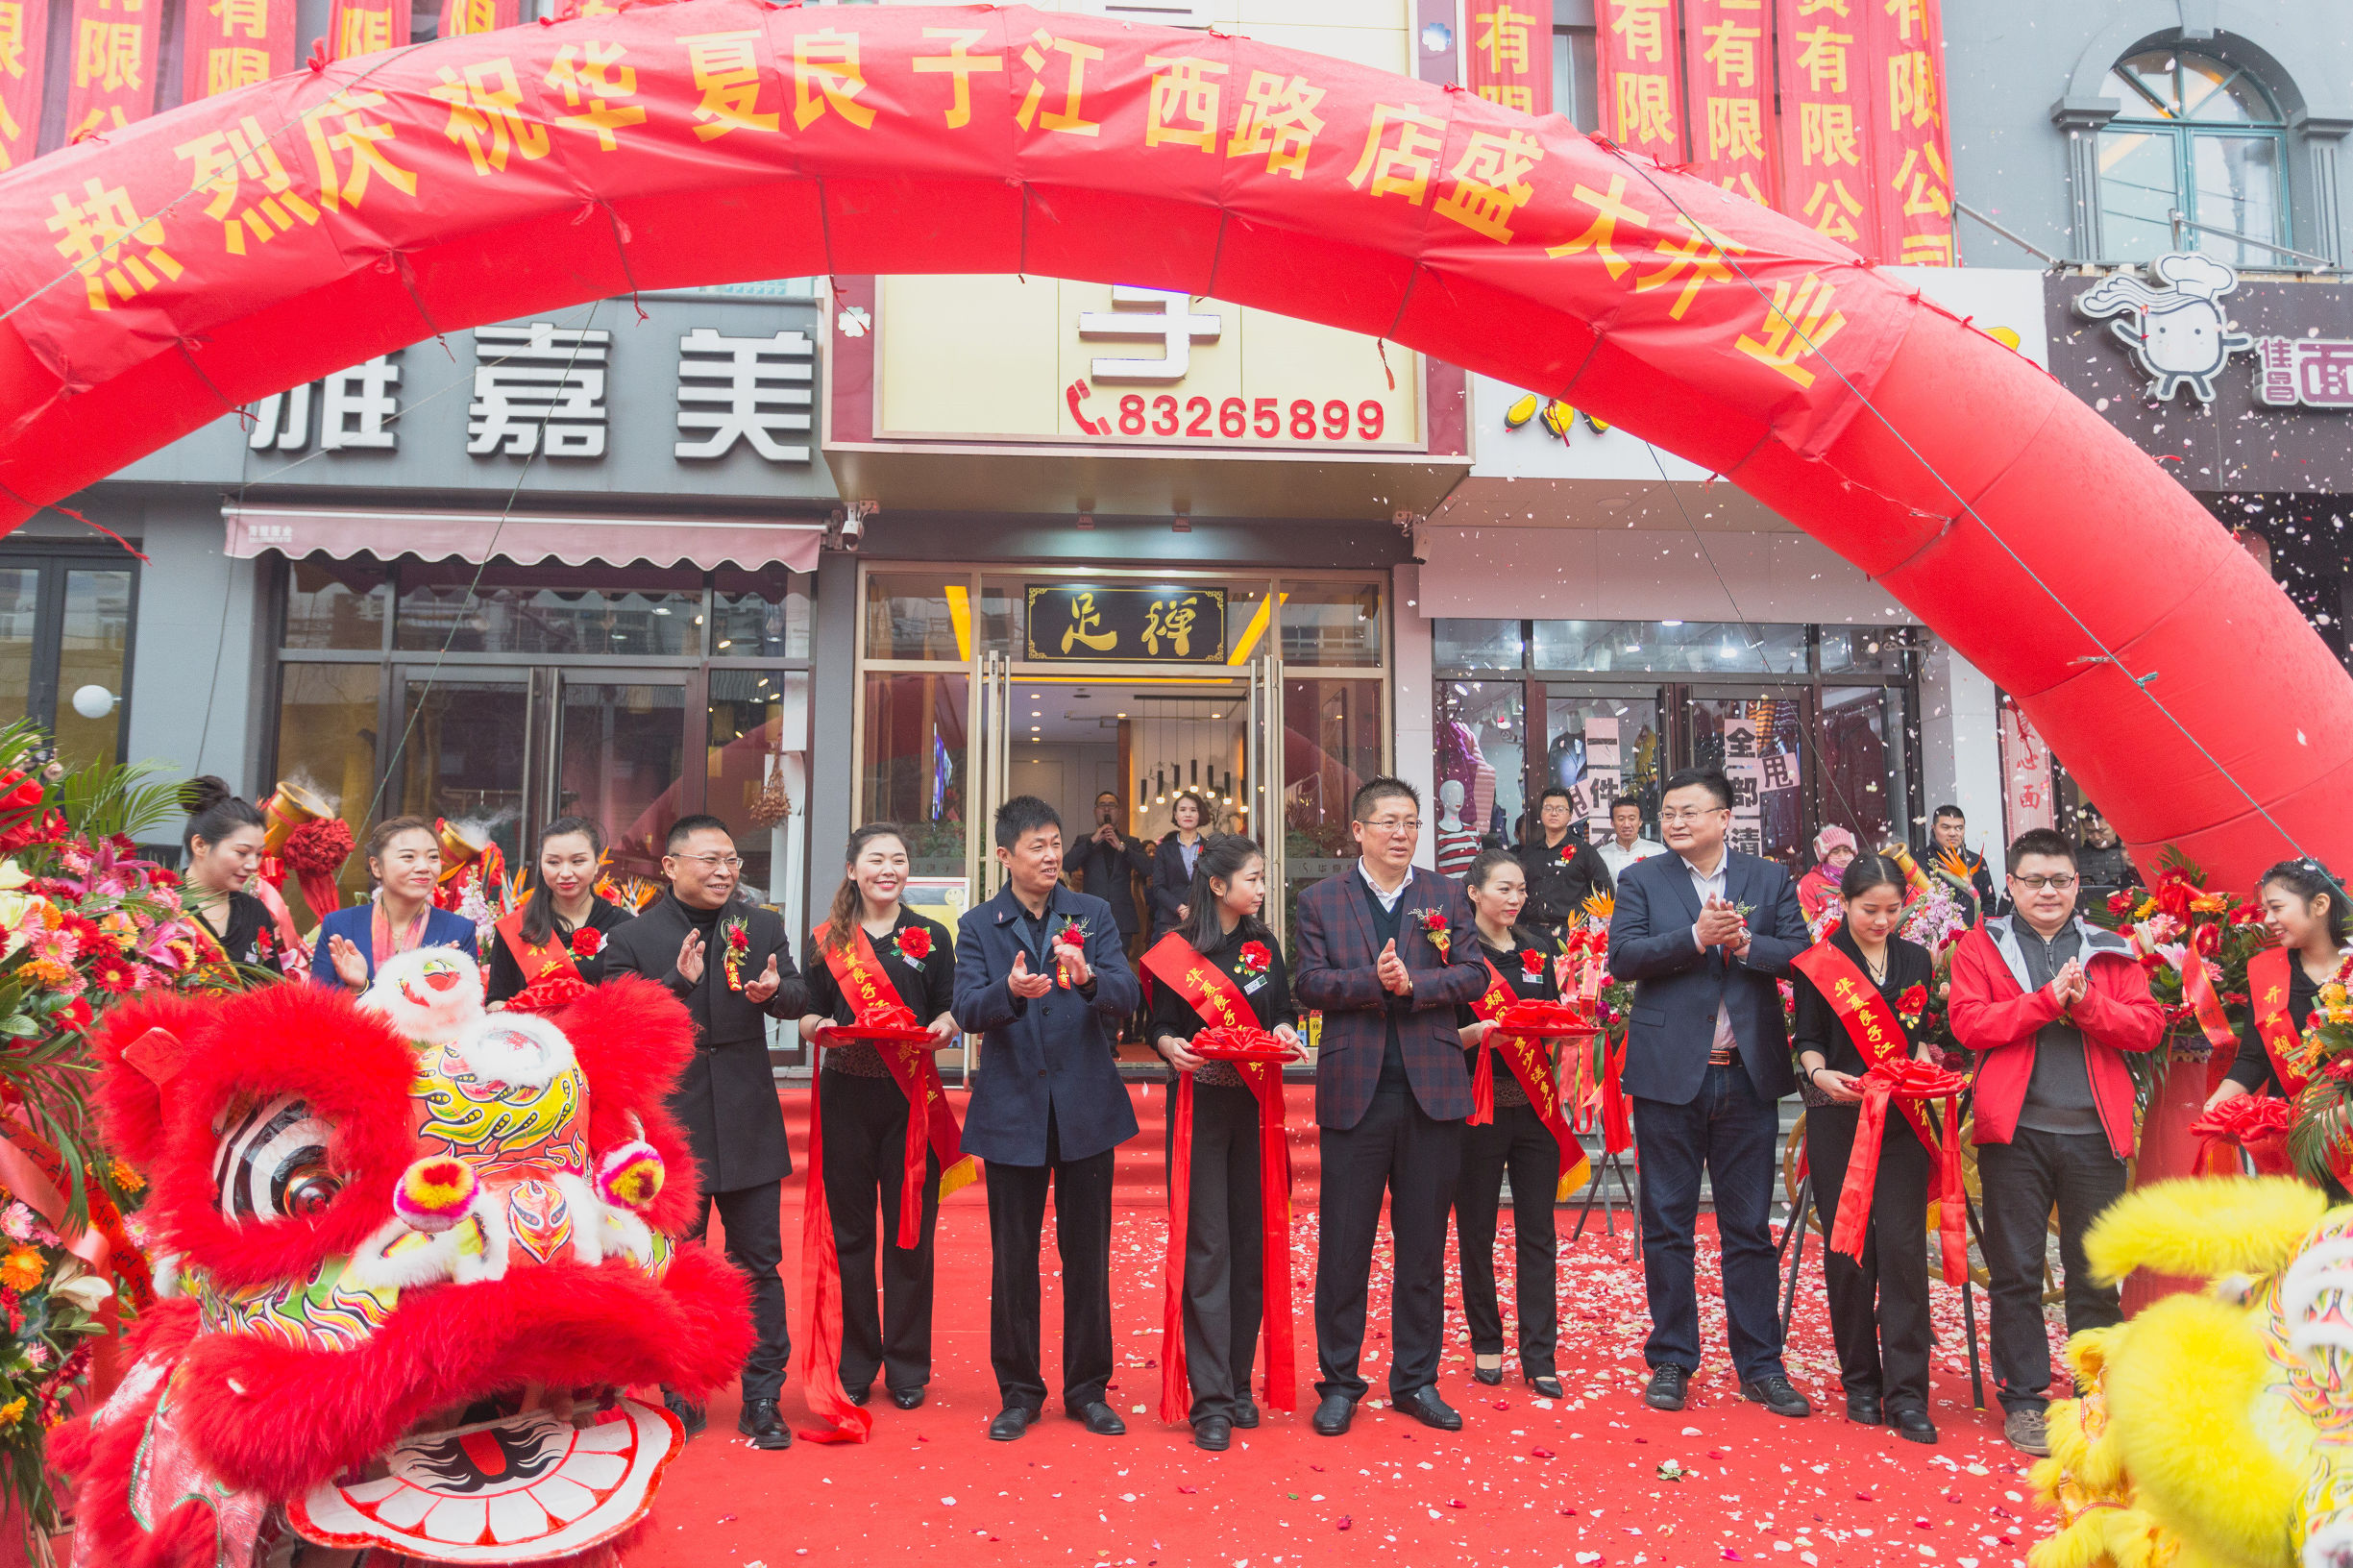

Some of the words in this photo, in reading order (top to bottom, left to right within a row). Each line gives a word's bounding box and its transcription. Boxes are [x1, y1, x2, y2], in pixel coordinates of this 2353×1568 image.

[45, 26, 1848, 389] 热烈庆祝华夏良子江西路店盛大开业
[1118, 394, 1385, 441] 83265899
[1761, 755, 1794, 789] 甩
[1834, 977, 1899, 1061] 华夏良子江
